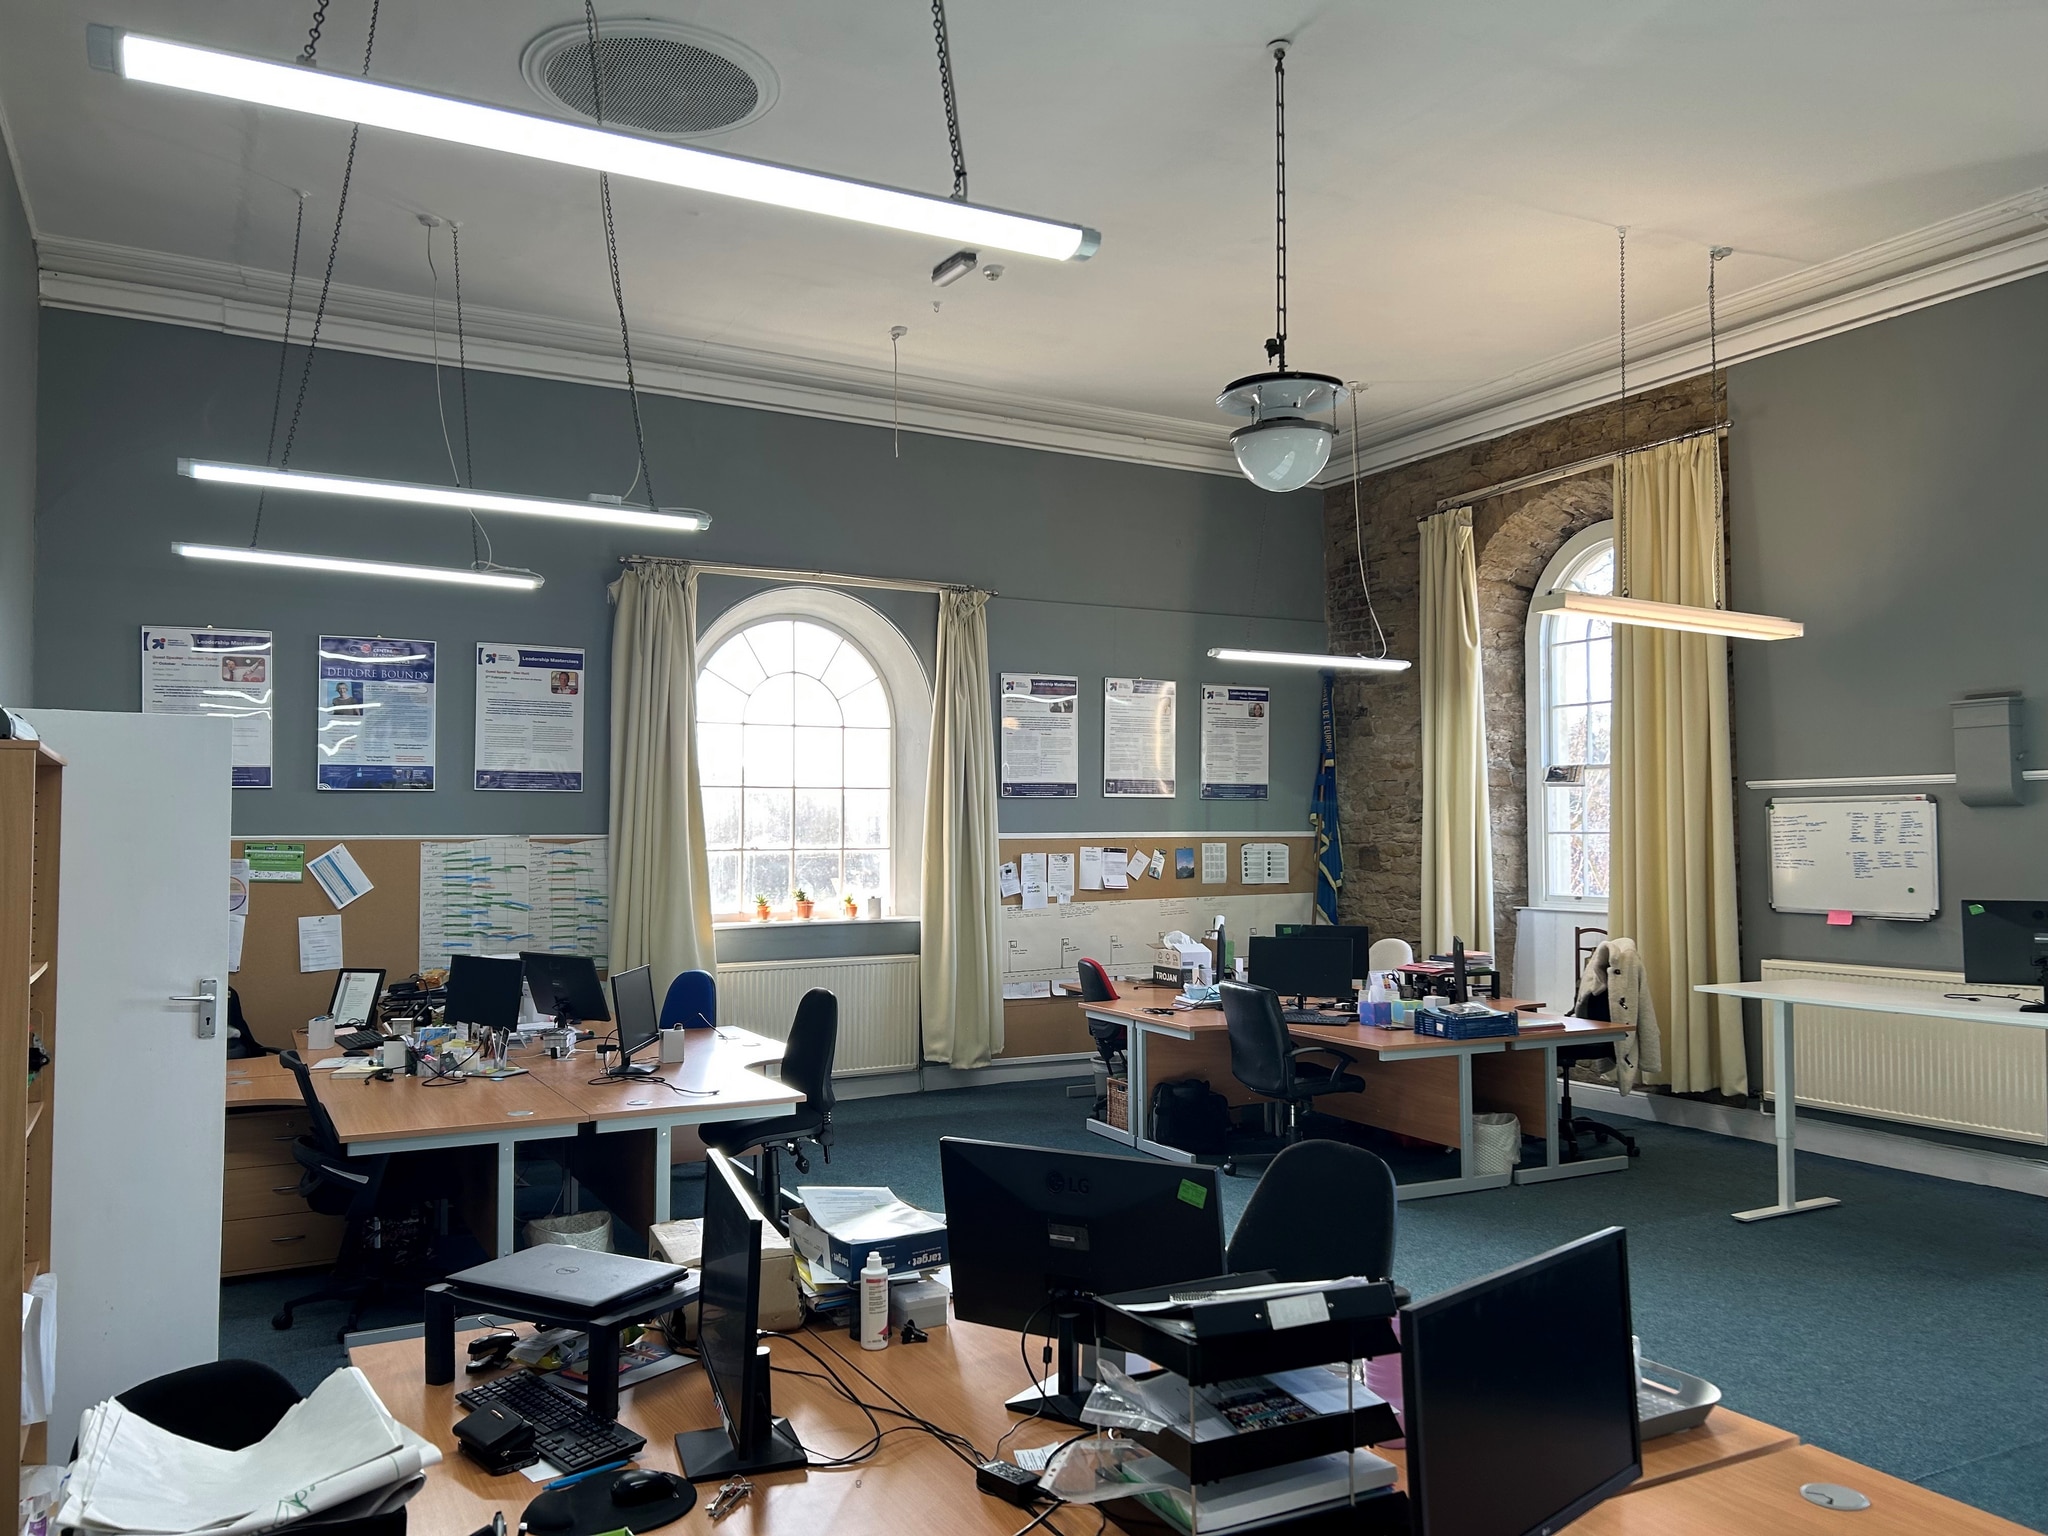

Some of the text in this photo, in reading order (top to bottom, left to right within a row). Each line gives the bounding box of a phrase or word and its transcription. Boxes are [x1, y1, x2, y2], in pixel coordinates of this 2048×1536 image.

[327, 667, 429, 680] DEIRDRE BOUNDS
[1322, 709, 1330, 719] DE
[1155, 971, 1178, 983] TROJAN
[1068, 1177, 1090, 1194] LG
[833, 1252, 850, 1268] target
[911, 1252, 942, 1267] target
